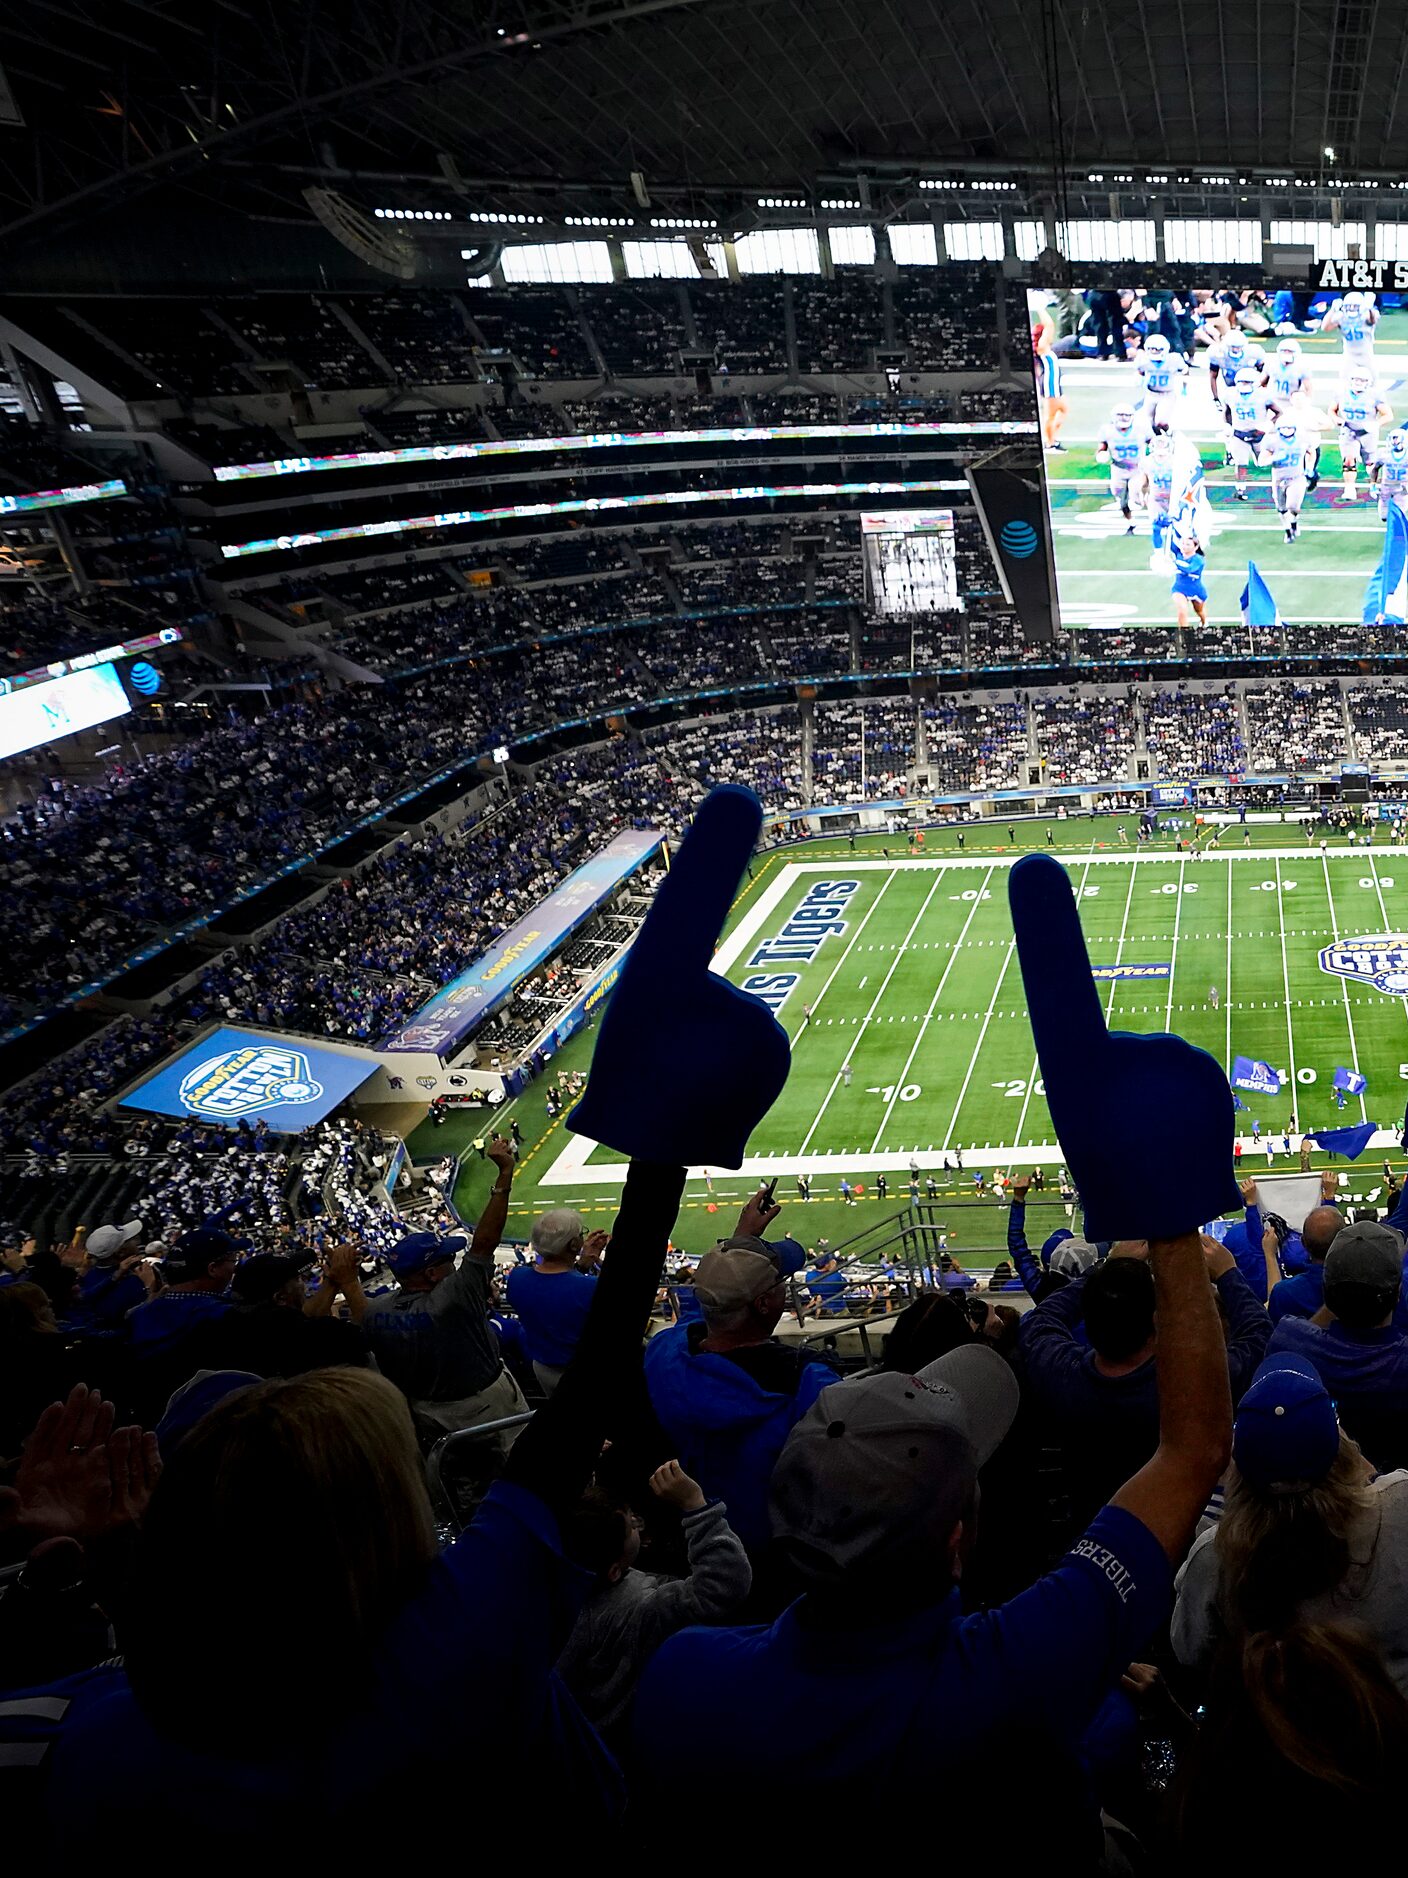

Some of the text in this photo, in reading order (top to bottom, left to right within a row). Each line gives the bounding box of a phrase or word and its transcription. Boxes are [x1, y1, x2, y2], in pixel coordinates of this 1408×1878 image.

[1318, 260, 1388, 288] AT&T
[1161, 883, 1198, 895] 30
[745, 880, 861, 968] Tigers
[481, 931, 541, 980] GOODYEAR
[585, 970, 619, 1011] GOODYEAR
[188, 1050, 258, 1102] GOODYEAR
[202, 1052, 293, 1109] COTTON
[234, 1067, 292, 1106] BOWL
[881, 1084, 922, 1102] 10
[1236, 1078, 1278, 1094] MEMPHIS
[1347, 1071, 1361, 1092] T
[1071, 1539, 1137, 1604] TIGERS
